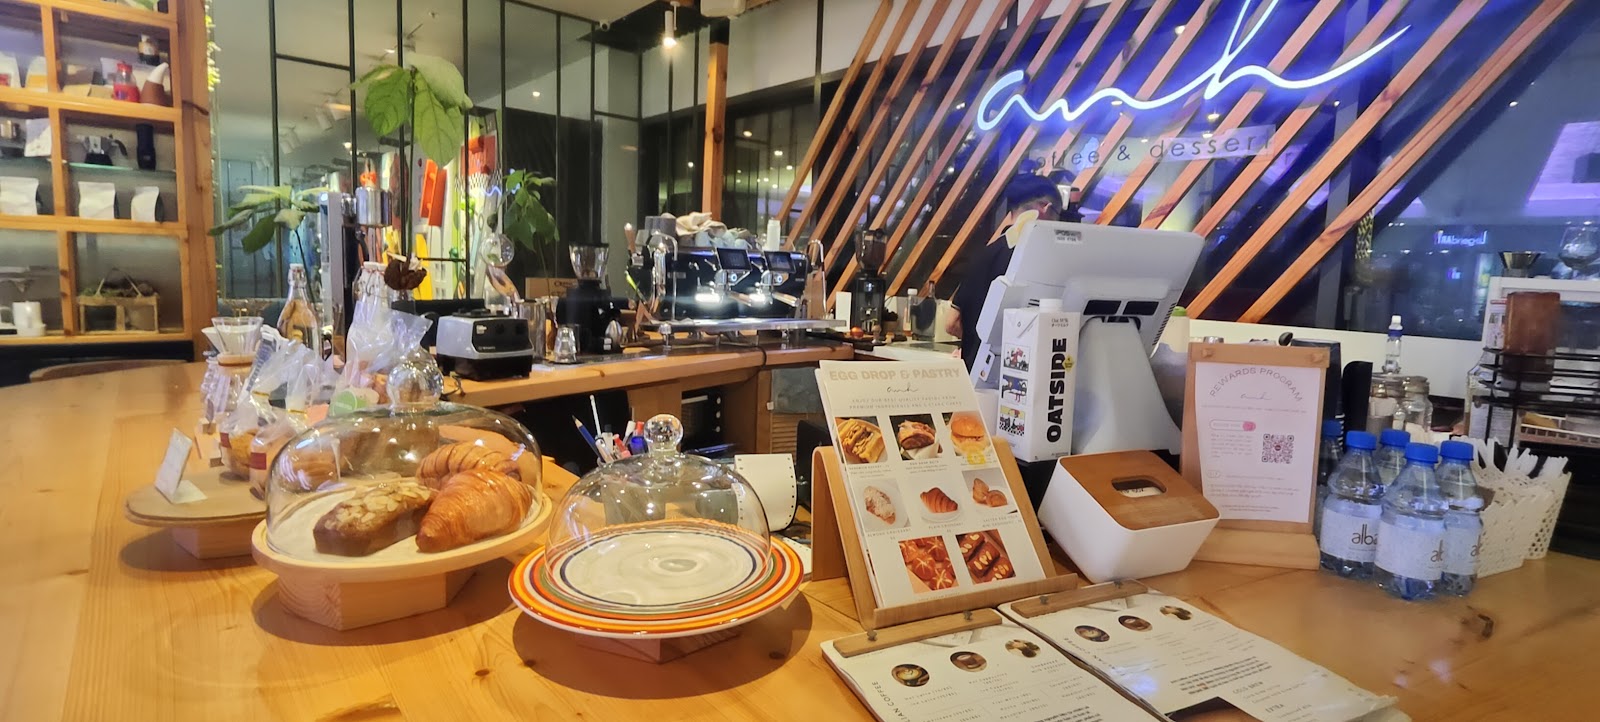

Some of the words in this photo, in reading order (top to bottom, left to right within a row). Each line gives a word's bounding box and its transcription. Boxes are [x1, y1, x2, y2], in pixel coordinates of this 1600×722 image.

[1117, 144, 1131, 161] &
[829, 371, 858, 381] EGG
[861, 370, 896, 380] DROP
[900, 370, 910, 379] &
[912, 368, 960, 379] PASTRY
[1209, 367, 1257, 397] REWARDS
[1259, 367, 1303, 402] PROGRAM
[1047, 338, 1067, 443] OATSIDE
